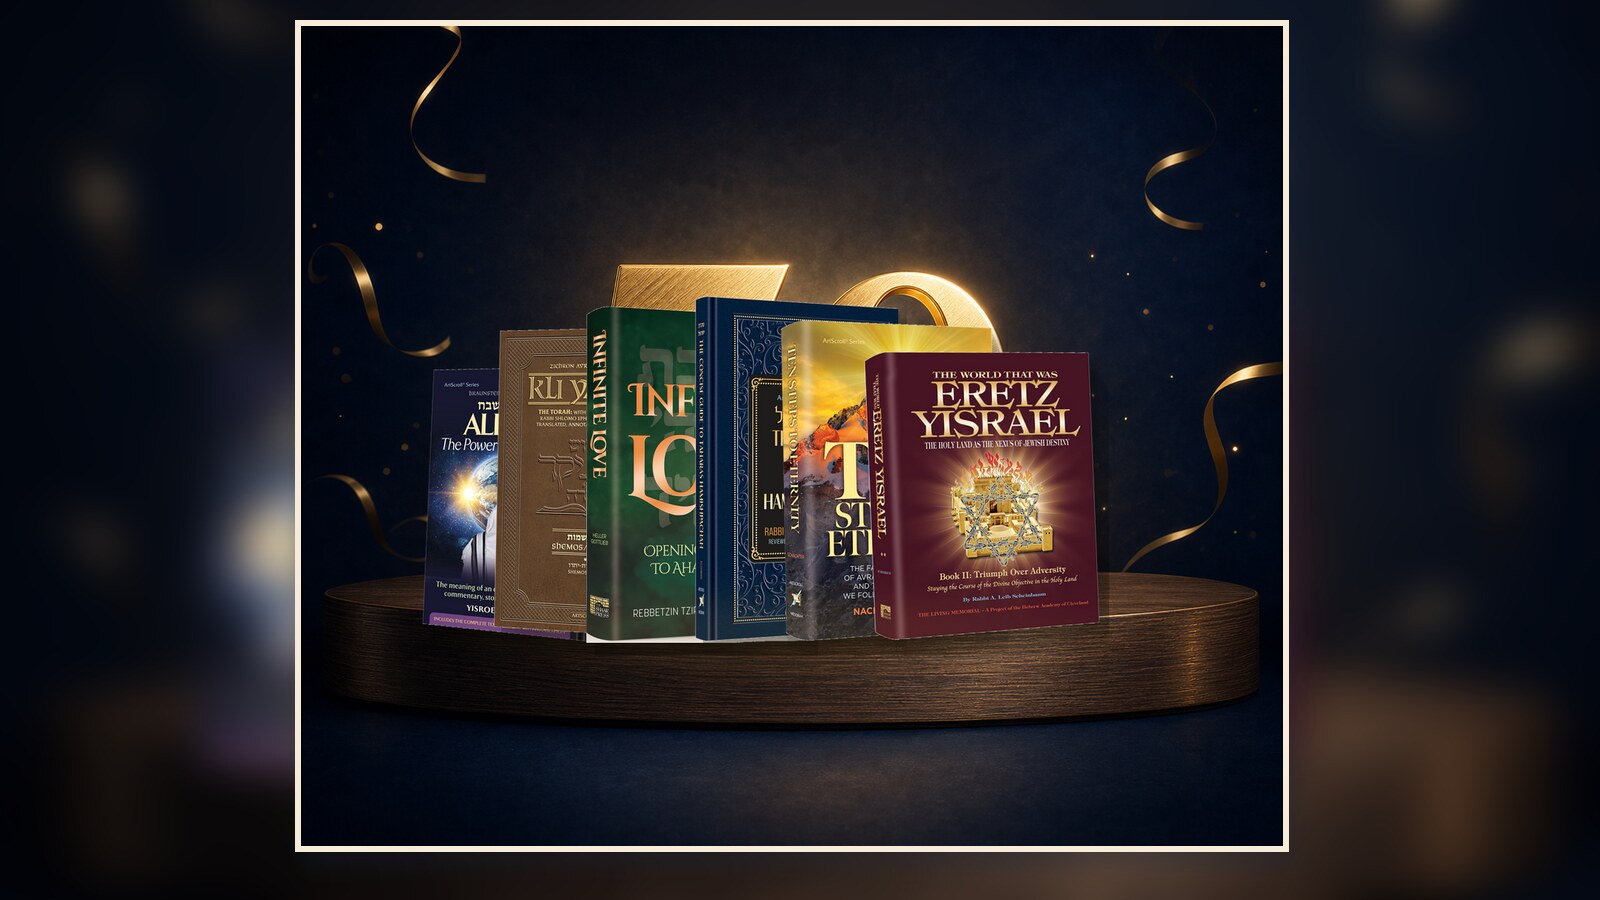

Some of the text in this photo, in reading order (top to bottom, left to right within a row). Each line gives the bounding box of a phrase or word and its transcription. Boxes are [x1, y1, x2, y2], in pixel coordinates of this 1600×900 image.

[787, 344, 797, 378] TEN
[932, 370, 1058, 379] THE WORLD THAT WAS
[569, 378, 588, 405] Y
[931, 379, 1061, 410] ERETZ
[589, 329, 607, 479] INFINITE LOVE
[627, 382, 696, 417] INF
[788, 379, 798, 427] STEPS
[911, 407, 1082, 439] YISRAEL
[699, 426, 704, 439] TO
[442, 437, 498, 452] The Power
[924, 441, 938, 450] THE
[938, 440, 956, 449] HOLY
[956, 440, 973, 449] LAND
[973, 440, 982, 448] AS
[982, 439, 994, 448] THE
[1014, 439, 1024, 447] OF
[1023, 438, 1046, 448] JEWISH
[1046, 437, 1071, 447] DESTINY
[628, 434, 696, 516] LO
[873, 408, 887, 540] ERETZ YISRAEL
[789, 454, 800, 534] ETERNITY
[764, 527, 785, 536] RABBI
[643, 544, 696, 558] OPENIN
[650, 562, 671, 575] TO
[939, 566, 1067, 581] Book II: Triumph Over Adversity
[843, 574, 855, 582] OF
[927, 585, 949, 594] Staying
[976, 581, 983, 591] of
[983, 580, 992, 588] the
[1010, 578, 1034, 588] Objective
[1064, 574, 1079, 582] Land
[436, 580, 448, 589] The
[448, 583, 476, 593] meaning
[444, 591, 485, 601] commentary,
[842, 592, 856, 600] WE
[633, 607, 679, 618] REBBETZIN
